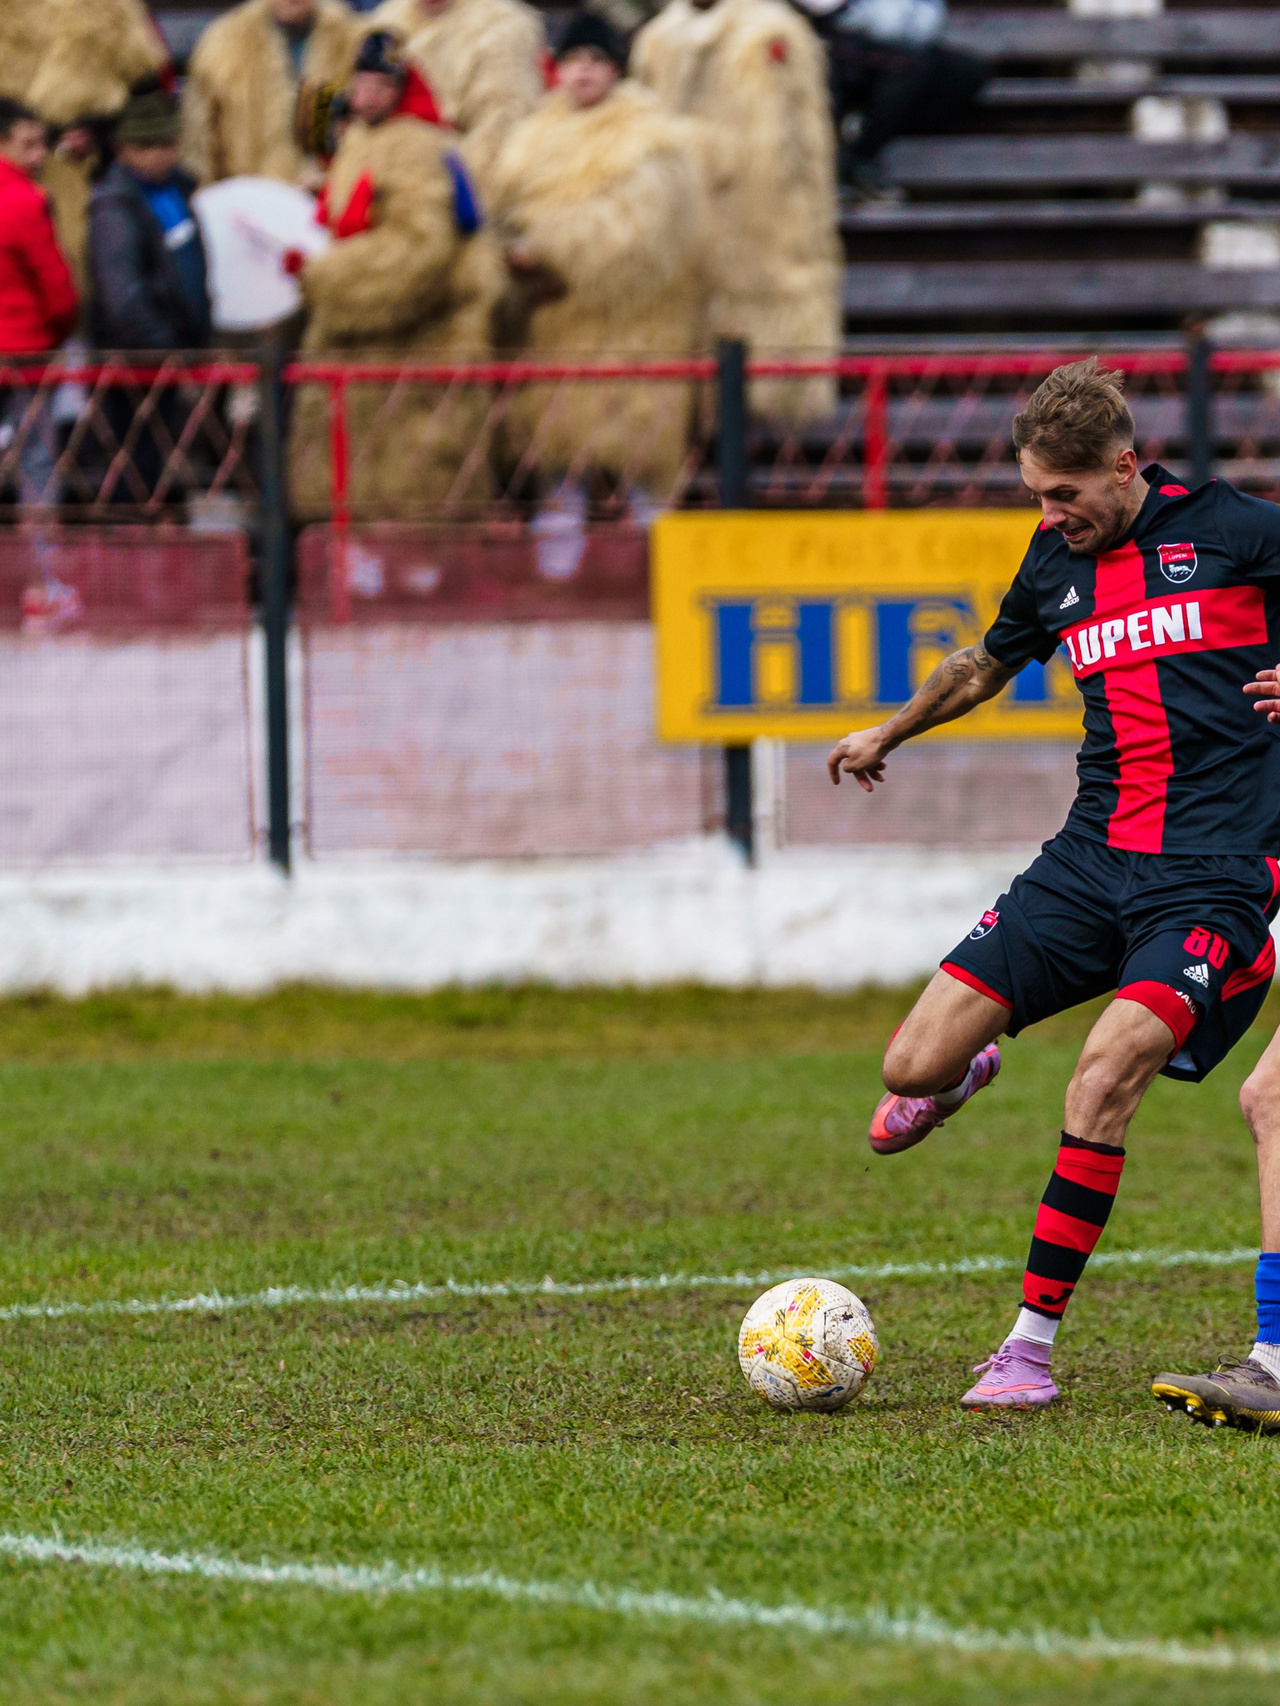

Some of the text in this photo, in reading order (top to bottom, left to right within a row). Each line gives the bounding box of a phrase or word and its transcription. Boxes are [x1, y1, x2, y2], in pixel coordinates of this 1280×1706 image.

[1168, 552, 1188, 561] LUPENI
[1059, 595, 1080, 610] adidas
[1066, 601, 1203, 671] LUPENI
[1182, 926, 1230, 970] 80
[1182, 967, 1210, 989] adidas
